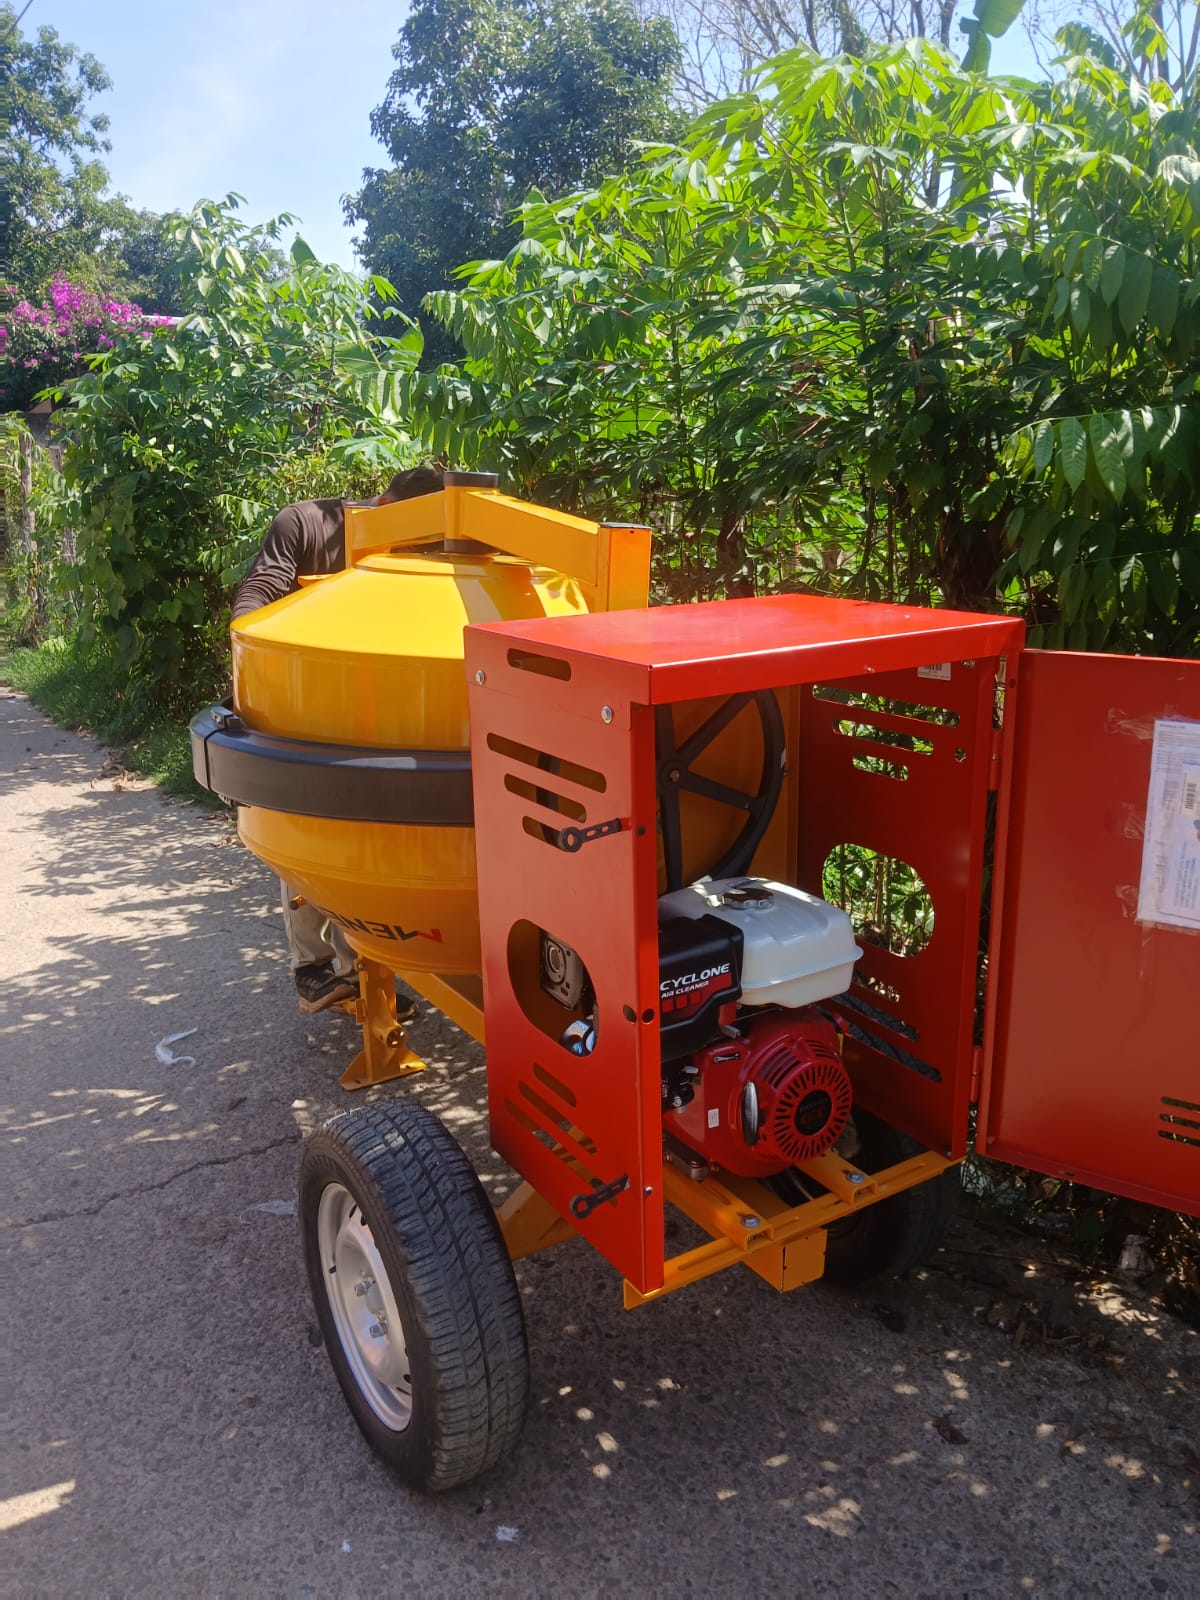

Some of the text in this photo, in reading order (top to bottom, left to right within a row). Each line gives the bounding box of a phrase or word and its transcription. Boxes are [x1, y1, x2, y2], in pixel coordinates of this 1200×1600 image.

[660, 962, 730, 991] CYCLONE
[661, 980, 710, 999] AIR CLEANER
